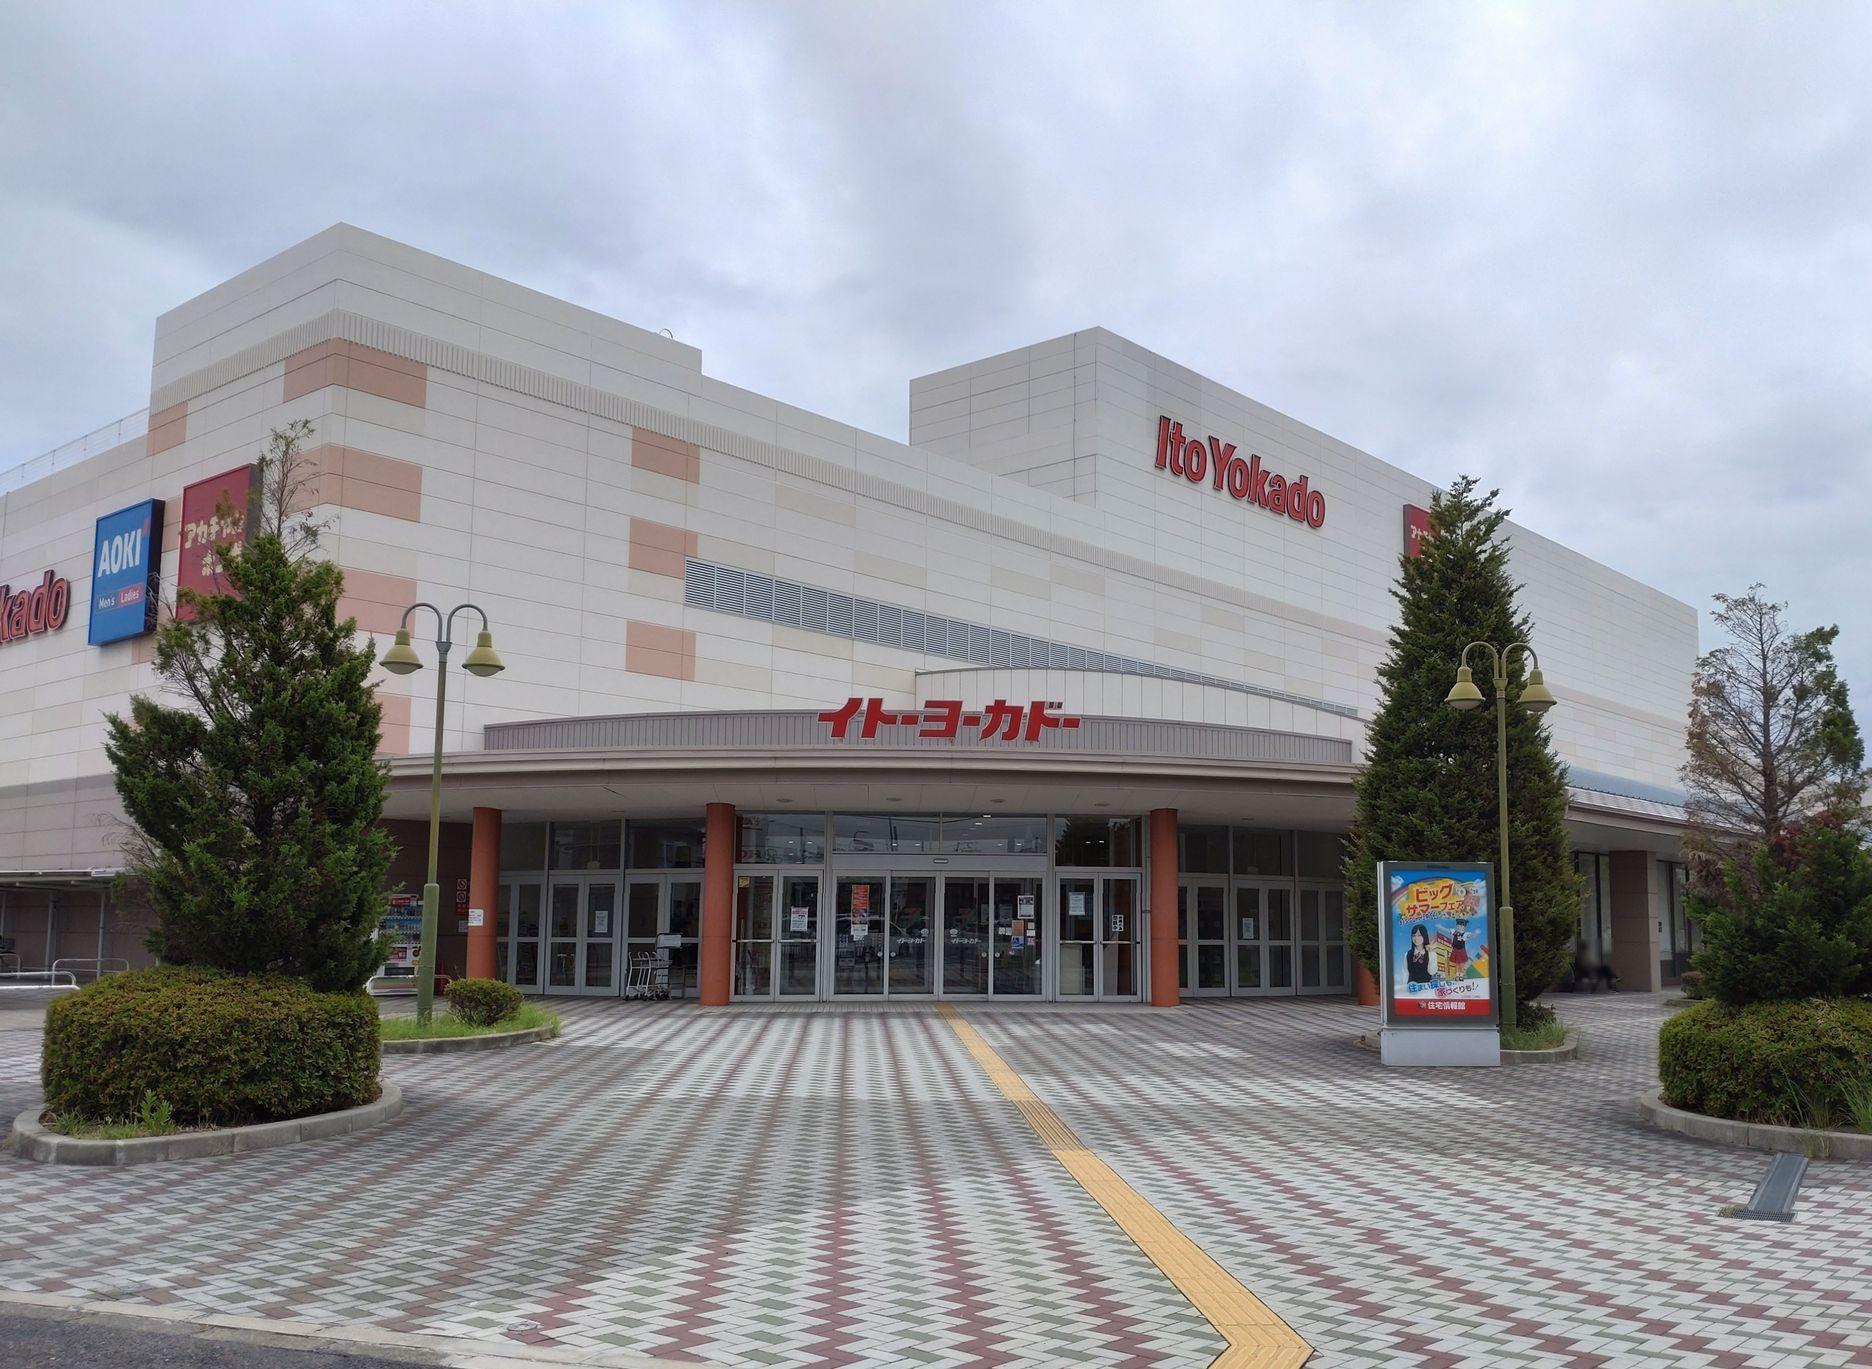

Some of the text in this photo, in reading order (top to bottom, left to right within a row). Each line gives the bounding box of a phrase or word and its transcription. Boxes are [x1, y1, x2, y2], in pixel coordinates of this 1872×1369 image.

[97, 528, 142, 578] AOKI
[120, 588, 140, 604] Ladies
[817, 697, 1081, 742] イトーヨーカドー
[1416, 883, 1453, 902] ビッグ
[1406, 900, 1464, 917] サマーフェア
